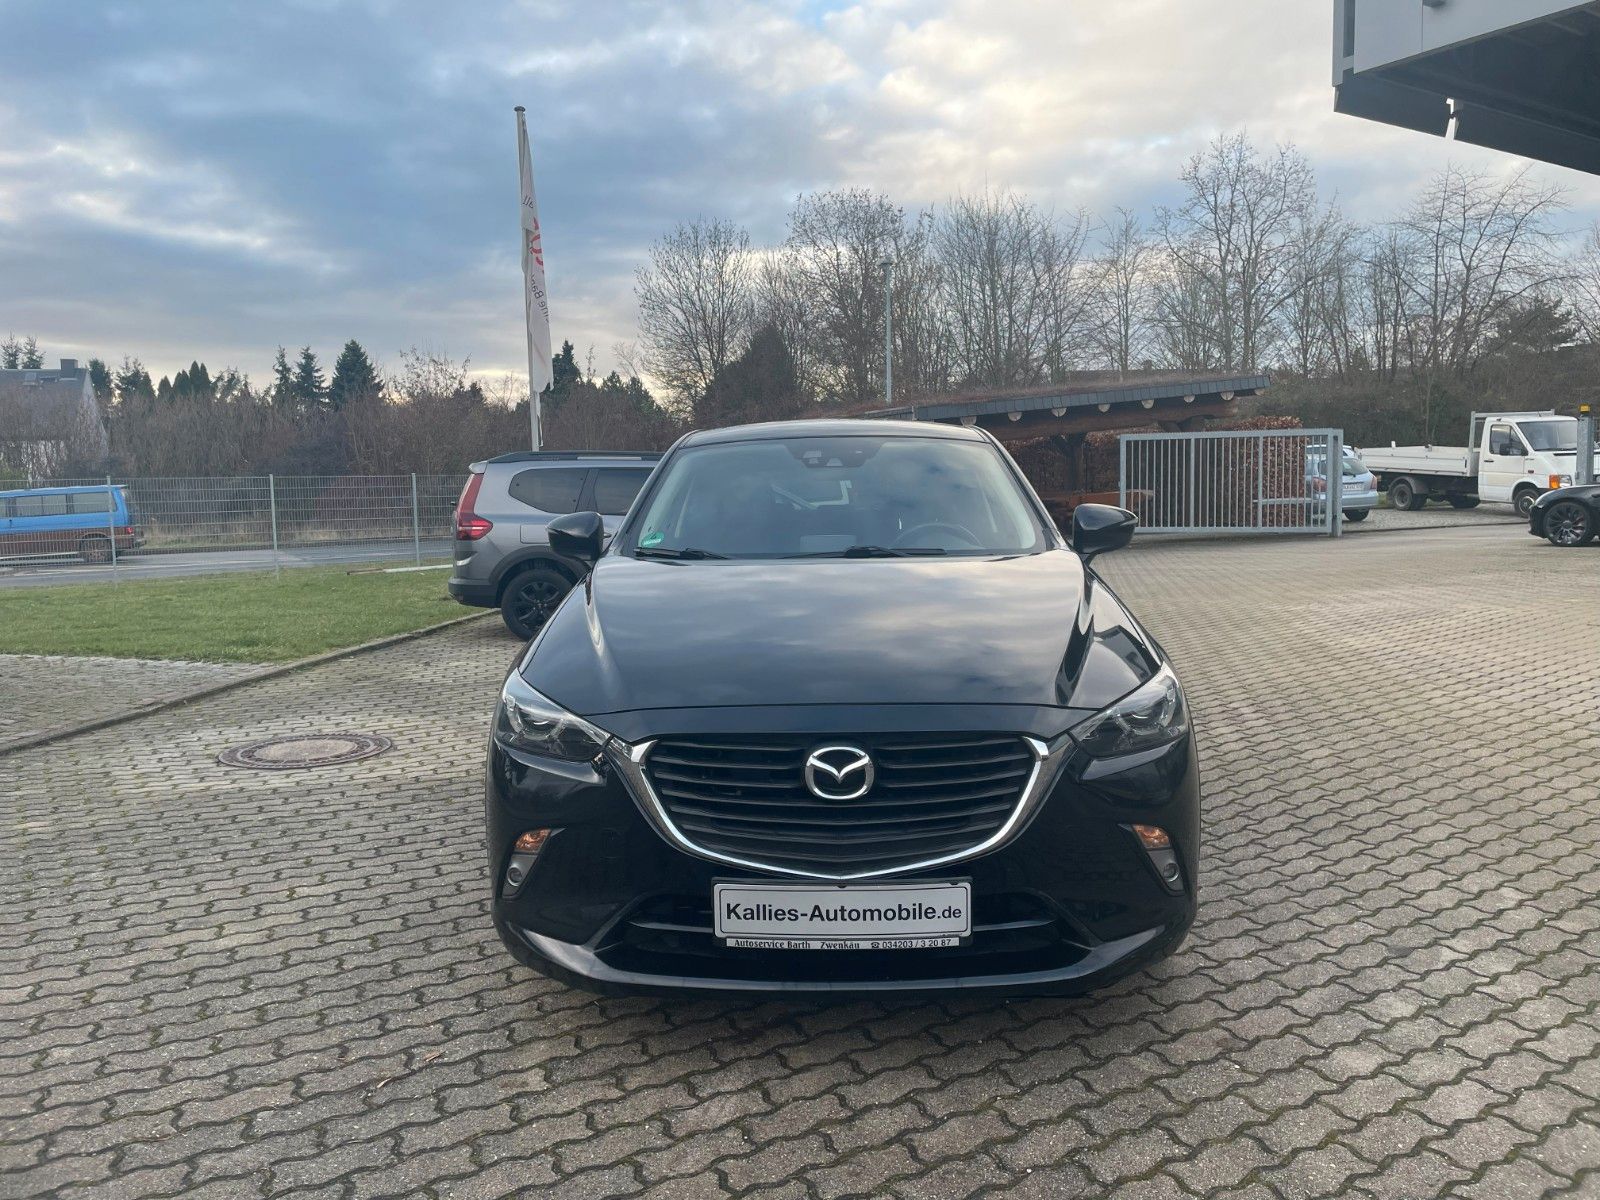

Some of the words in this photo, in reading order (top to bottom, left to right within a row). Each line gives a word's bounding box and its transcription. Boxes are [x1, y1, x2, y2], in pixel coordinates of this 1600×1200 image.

[726, 902, 962, 922] Kallies-Automobile.de
[734, 939, 785, 948] Autoservice
[787, 940, 811, 949] Barth
[820, 940, 860, 949] Zwenkau
[882, 940, 914, 949] 034203
[928, 938, 939, 947] 20
[941, 938, 952, 947] 87
